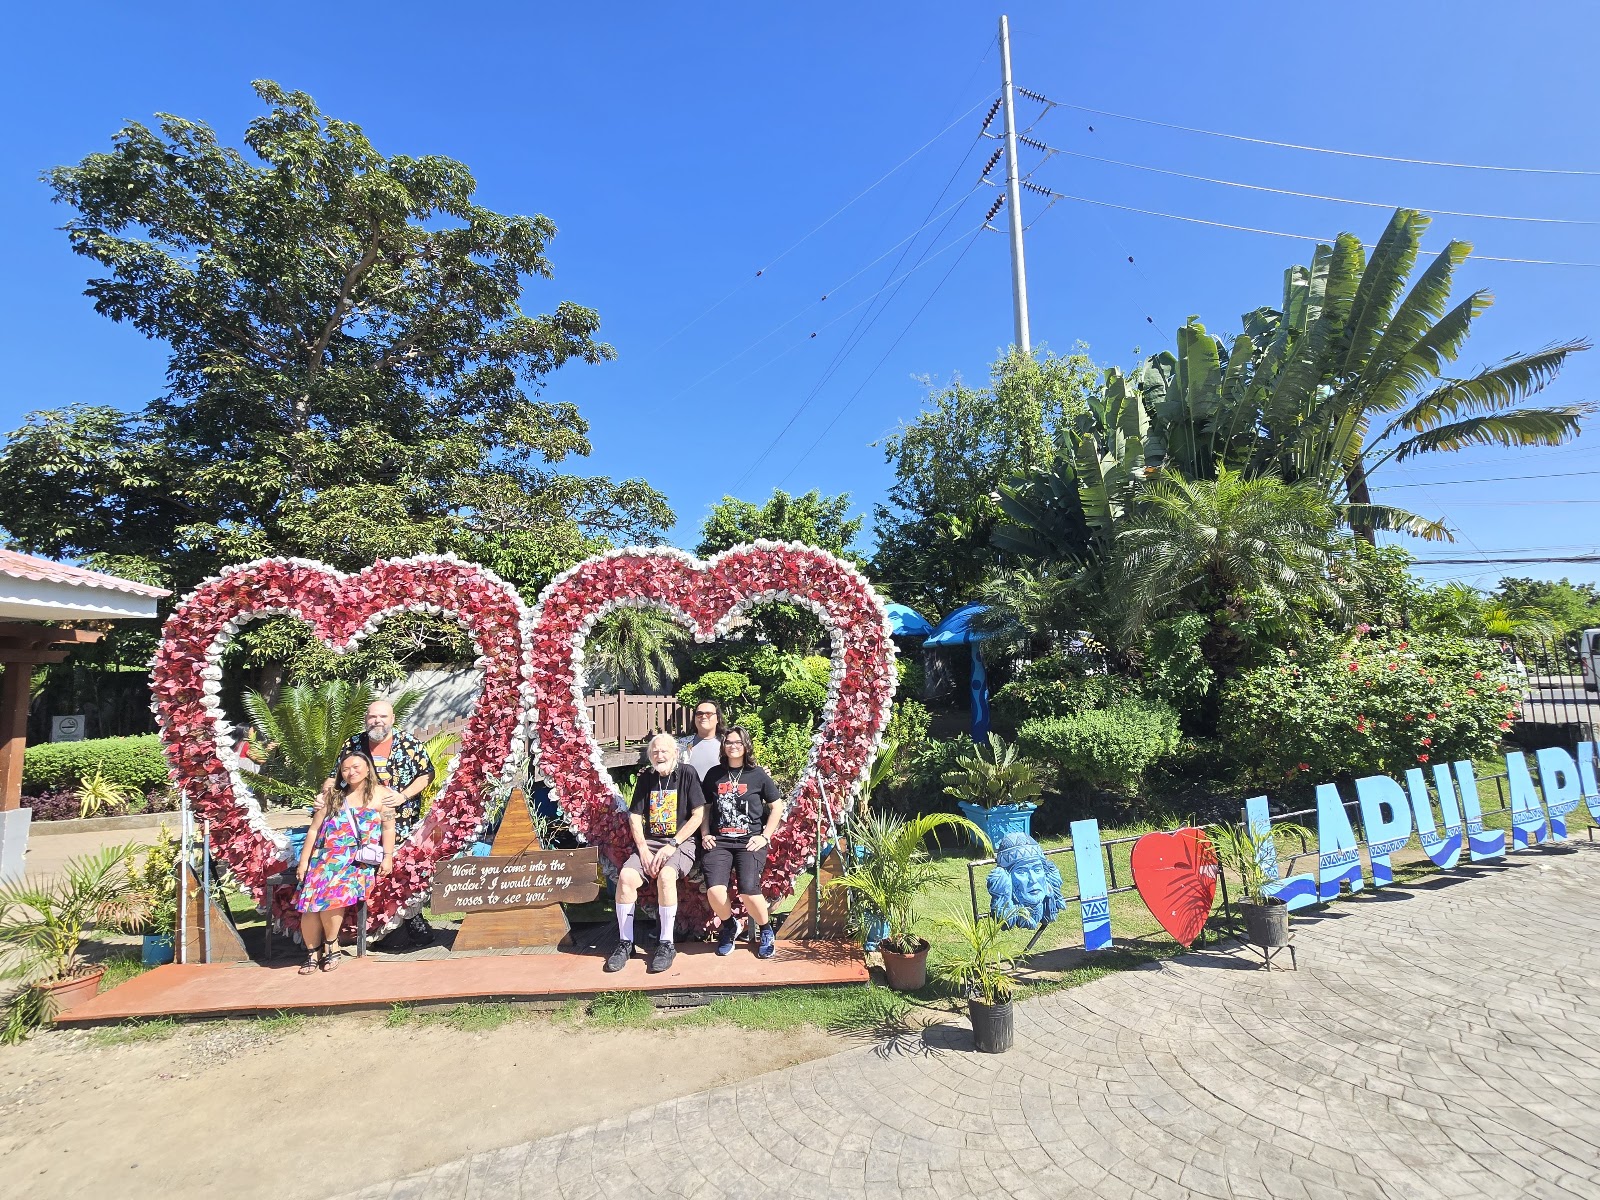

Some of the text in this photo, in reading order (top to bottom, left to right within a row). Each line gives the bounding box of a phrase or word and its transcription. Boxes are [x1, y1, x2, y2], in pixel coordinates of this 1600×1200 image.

[480, 866, 500, 878] you
[502, 864, 527, 873] come
[528, 860, 548, 872] into
[550, 859, 566, 871] the
[442, 873, 573, 898] garden? I would like my
[454, 887, 554, 907] roses to see you."
